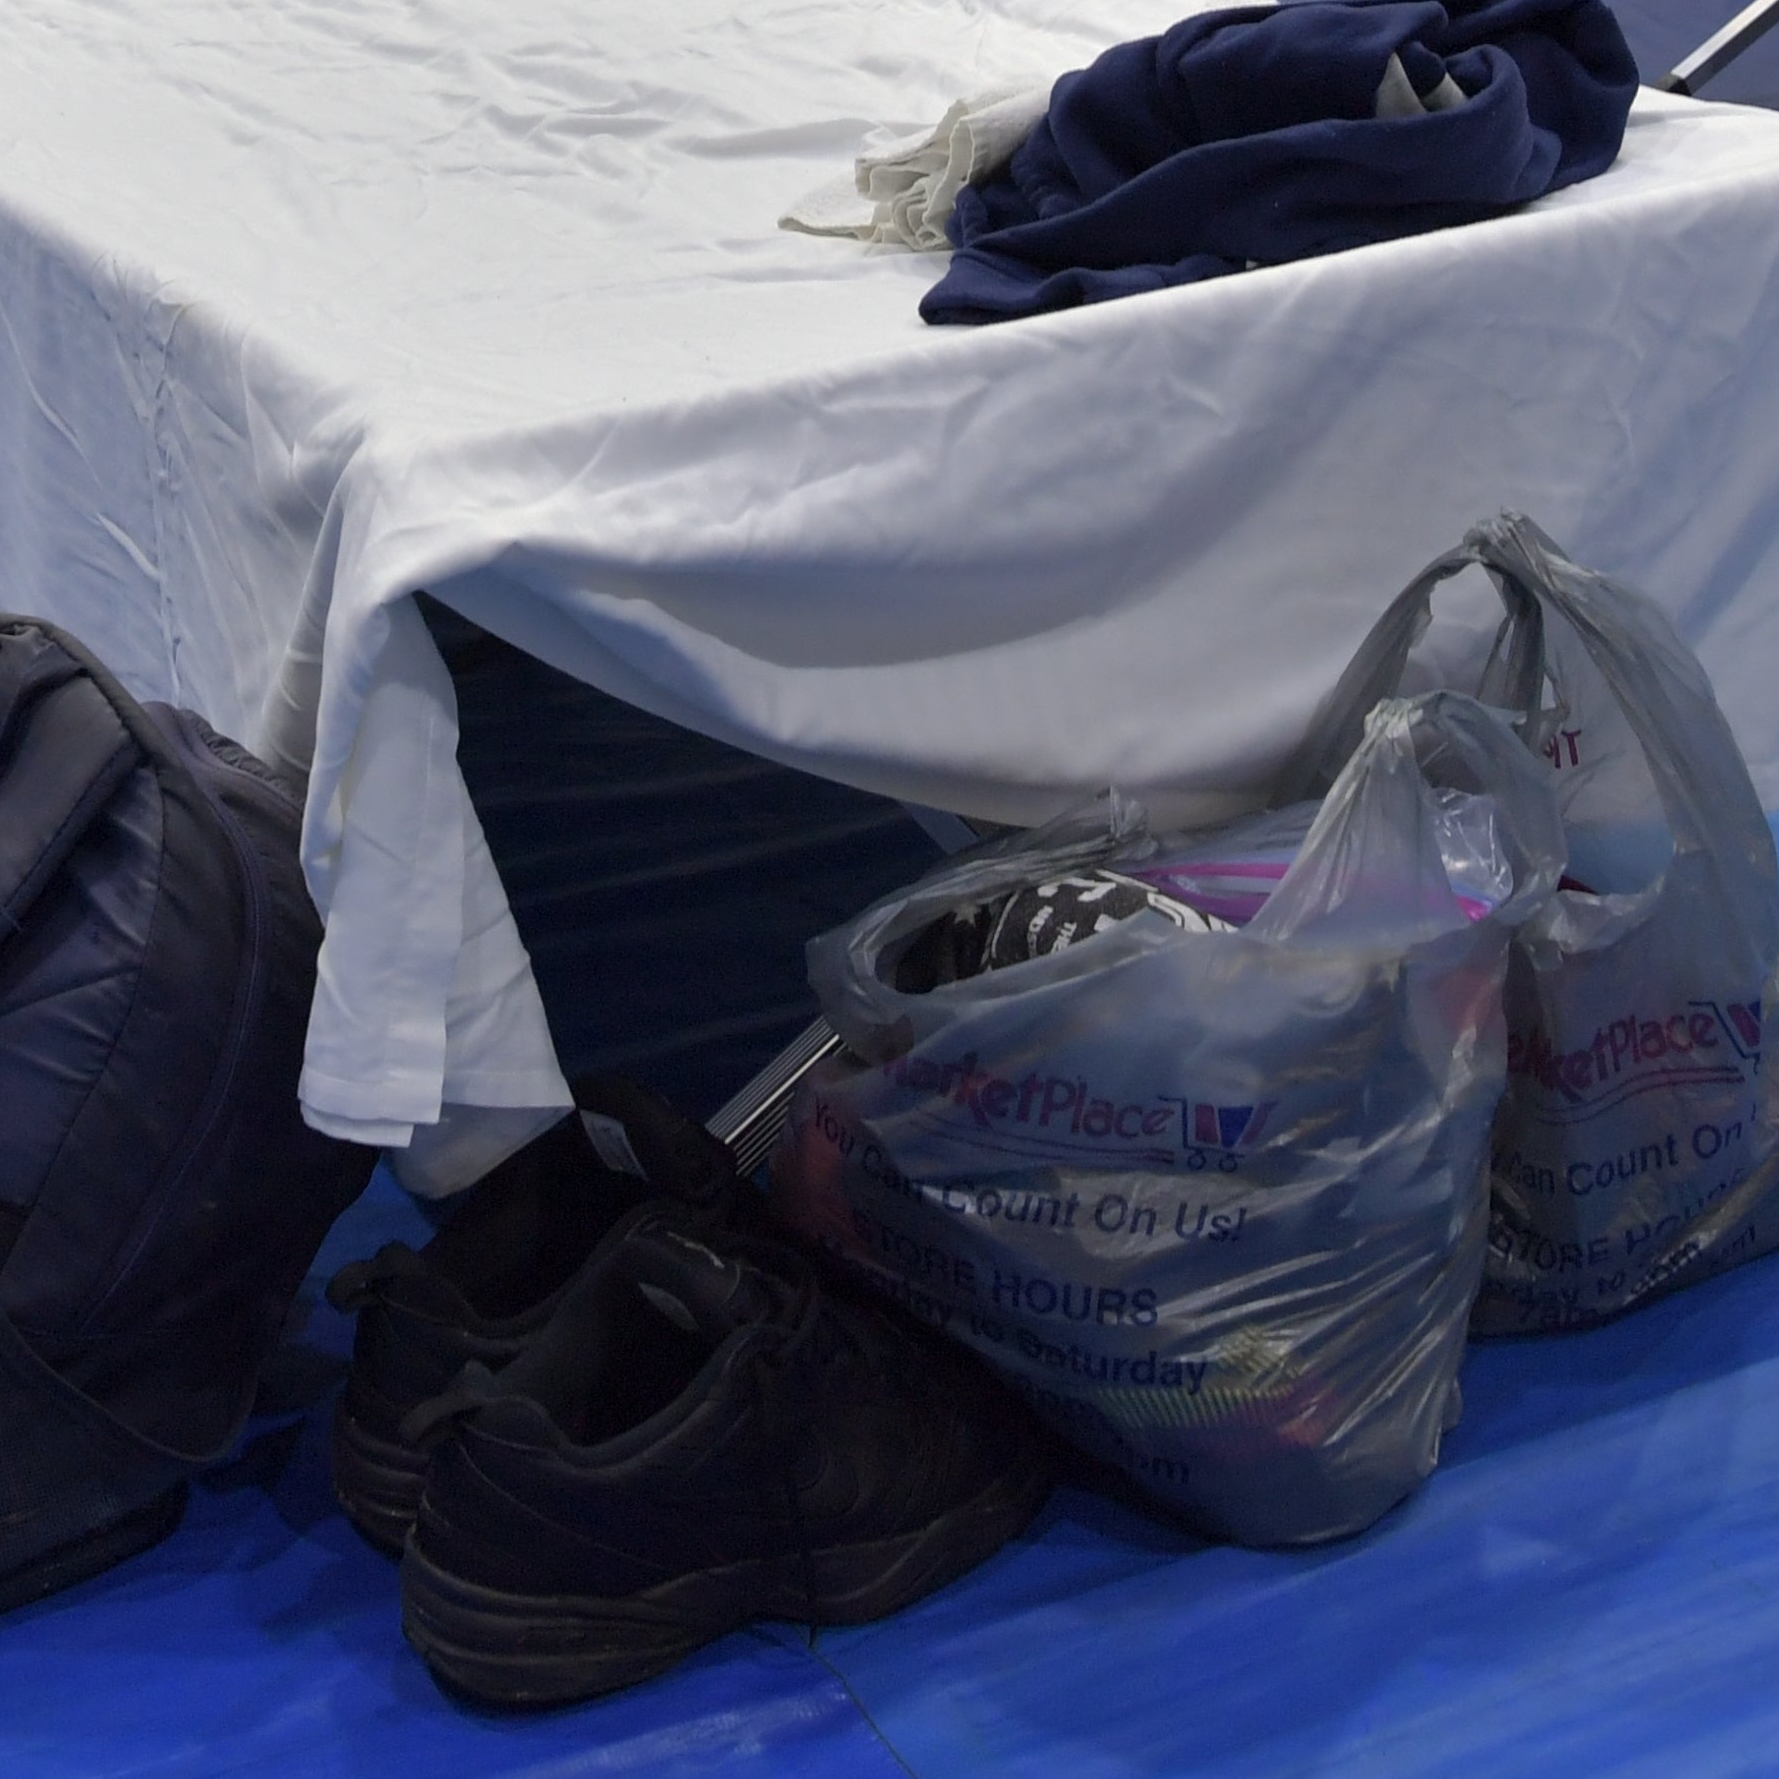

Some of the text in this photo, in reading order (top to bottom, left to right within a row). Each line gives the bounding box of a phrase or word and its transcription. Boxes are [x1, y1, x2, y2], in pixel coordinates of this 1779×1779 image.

[1566, 1132, 1680, 1197] Count
[1691, 1122, 1743, 1161] On
[941, 1183, 1079, 1229] Count
[1093, 1193, 1157, 1237] On
[1174, 1201, 1248, 1243] Us!
[991, 1268, 1159, 1328] HOURS
[1020, 1325, 1210, 1396] Saturday
